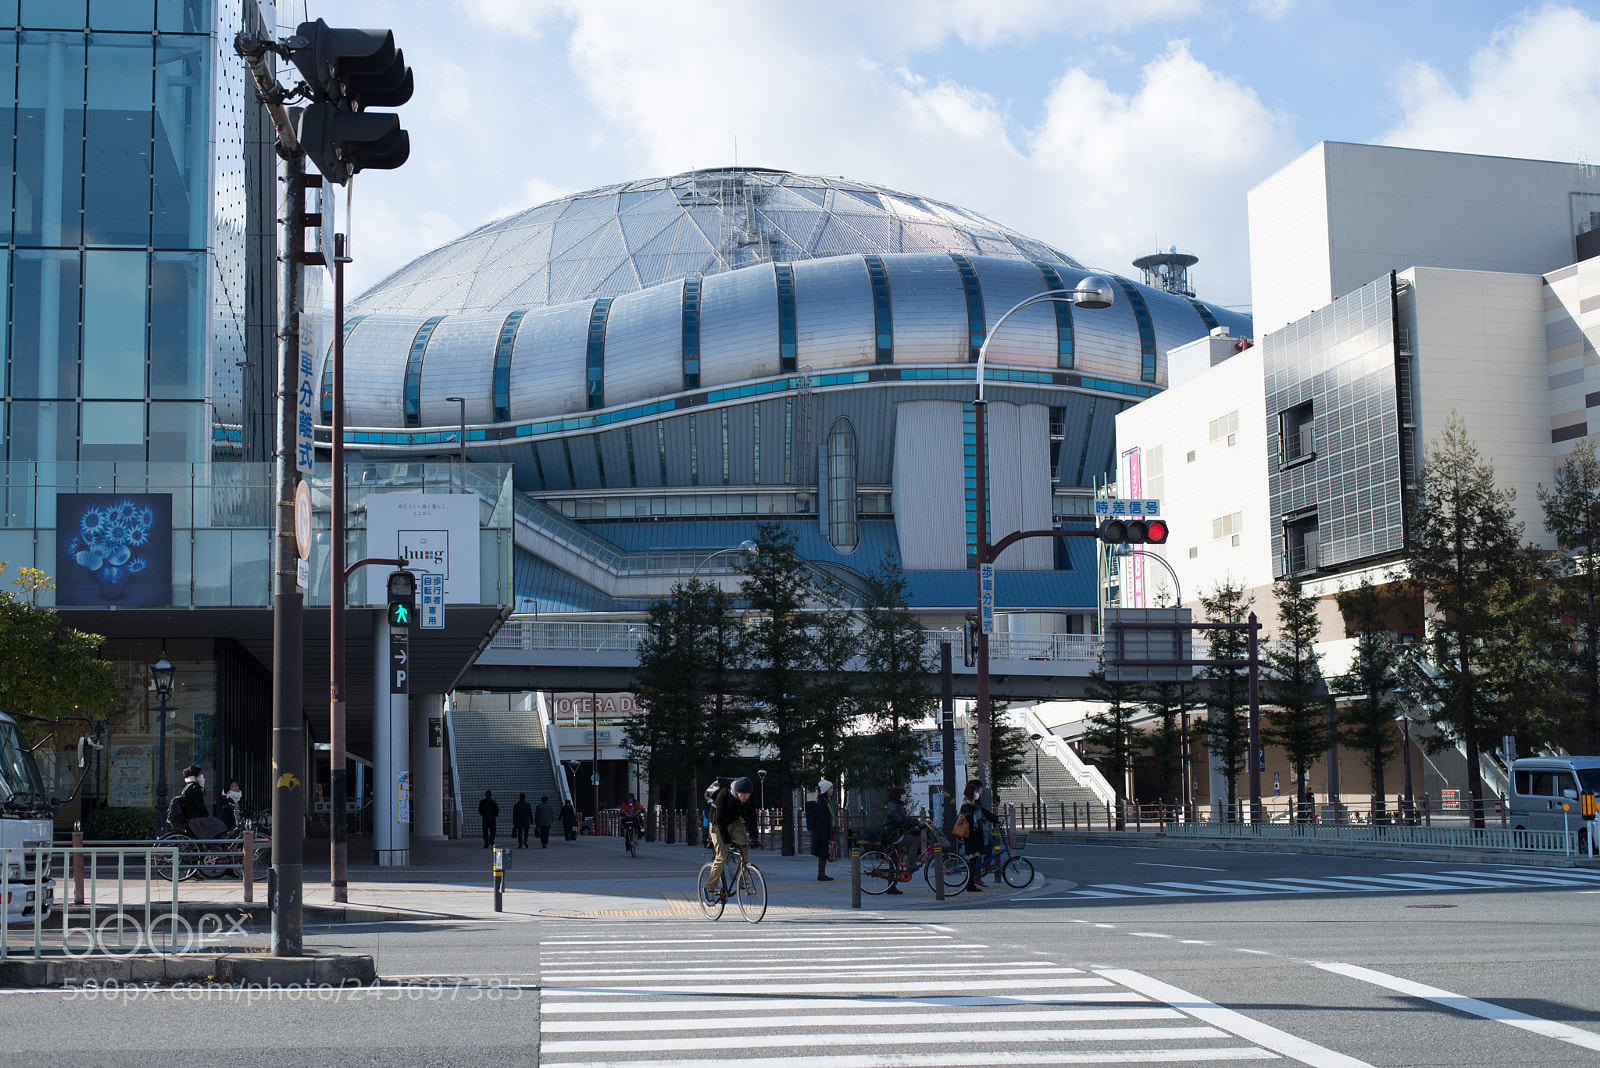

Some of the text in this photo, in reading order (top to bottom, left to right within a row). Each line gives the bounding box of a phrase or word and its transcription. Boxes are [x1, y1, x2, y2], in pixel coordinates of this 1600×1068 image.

[300, 320, 314, 470] 歩車分離式
[1095, 501, 1158, 514] 時差信号
[424, 577, 432, 604] 自転車
[433, 577, 442, 604] 歩行者
[982, 565, 993, 632] 歩車分離式
[428, 606, 437, 625] 専用
[396, 670, 406, 687] P
[545, 697, 616, 713] YOCERA
